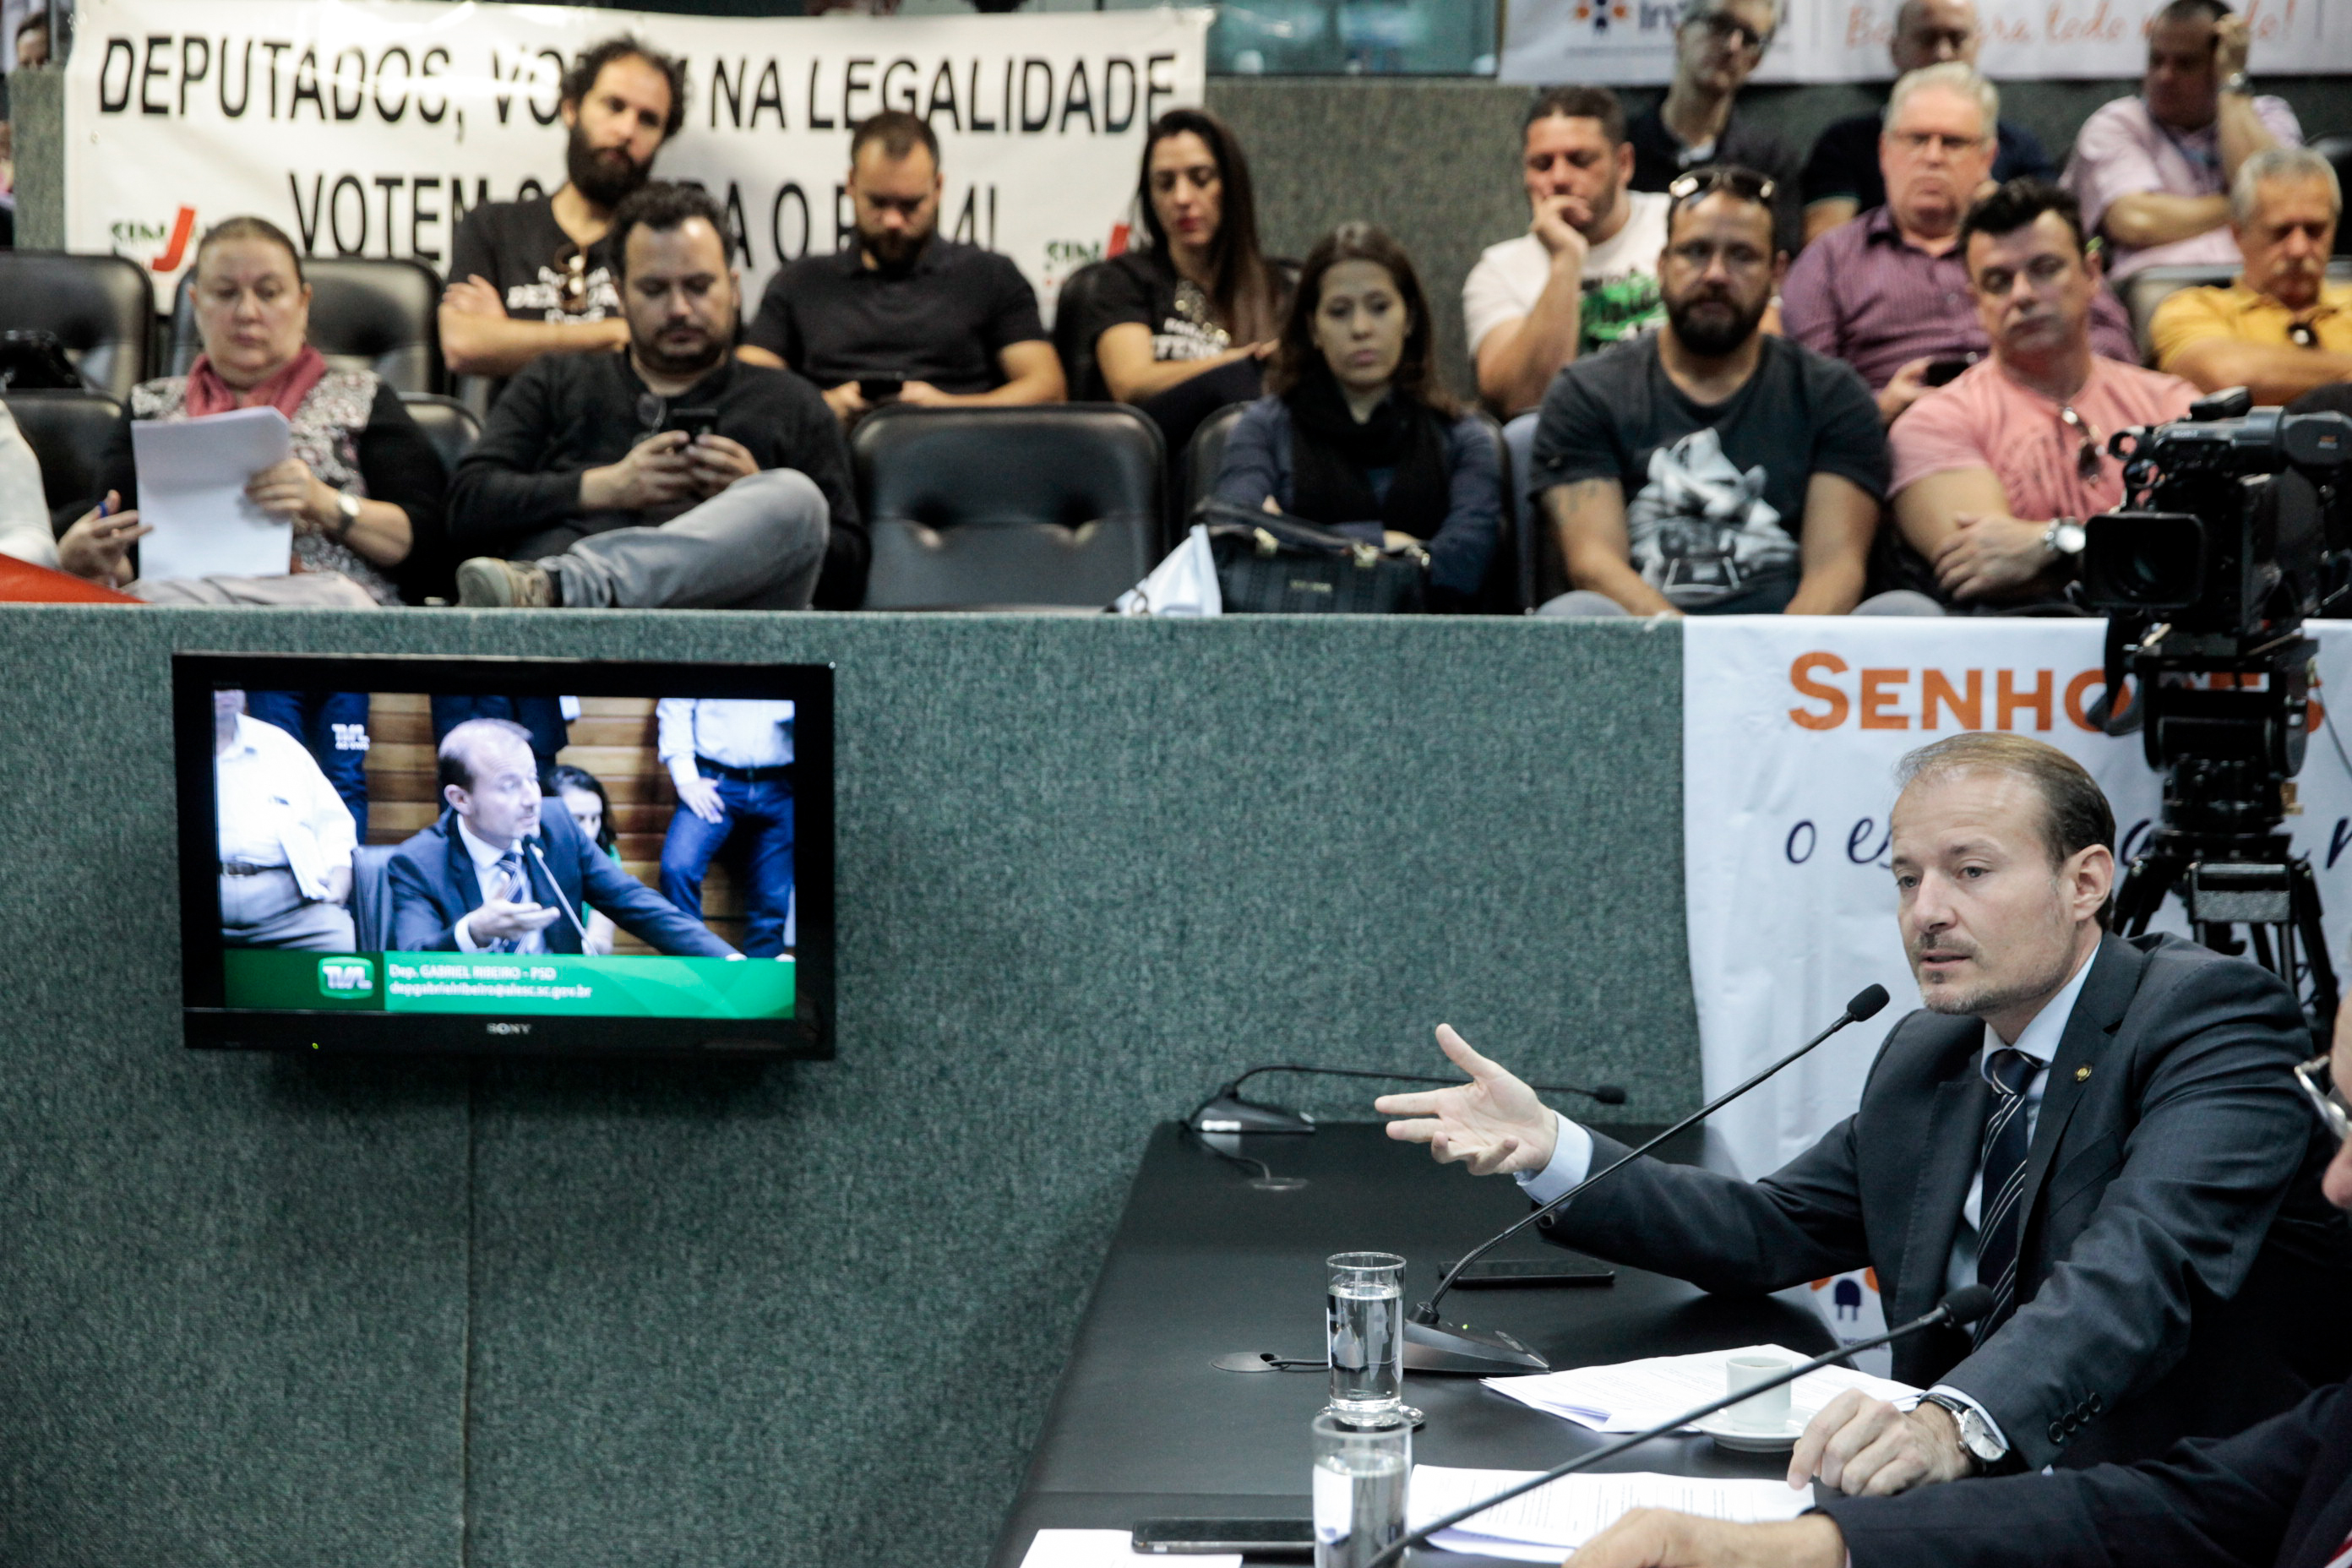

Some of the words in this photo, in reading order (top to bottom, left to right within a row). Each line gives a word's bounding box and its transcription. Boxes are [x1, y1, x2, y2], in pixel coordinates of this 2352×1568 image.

[99, 35, 465, 144] DEPUTADOS,
[710, 57, 787, 130] NA
[808, 54, 1175, 133] LEGALIDADE
[487, 1022, 531, 1035] SONY
